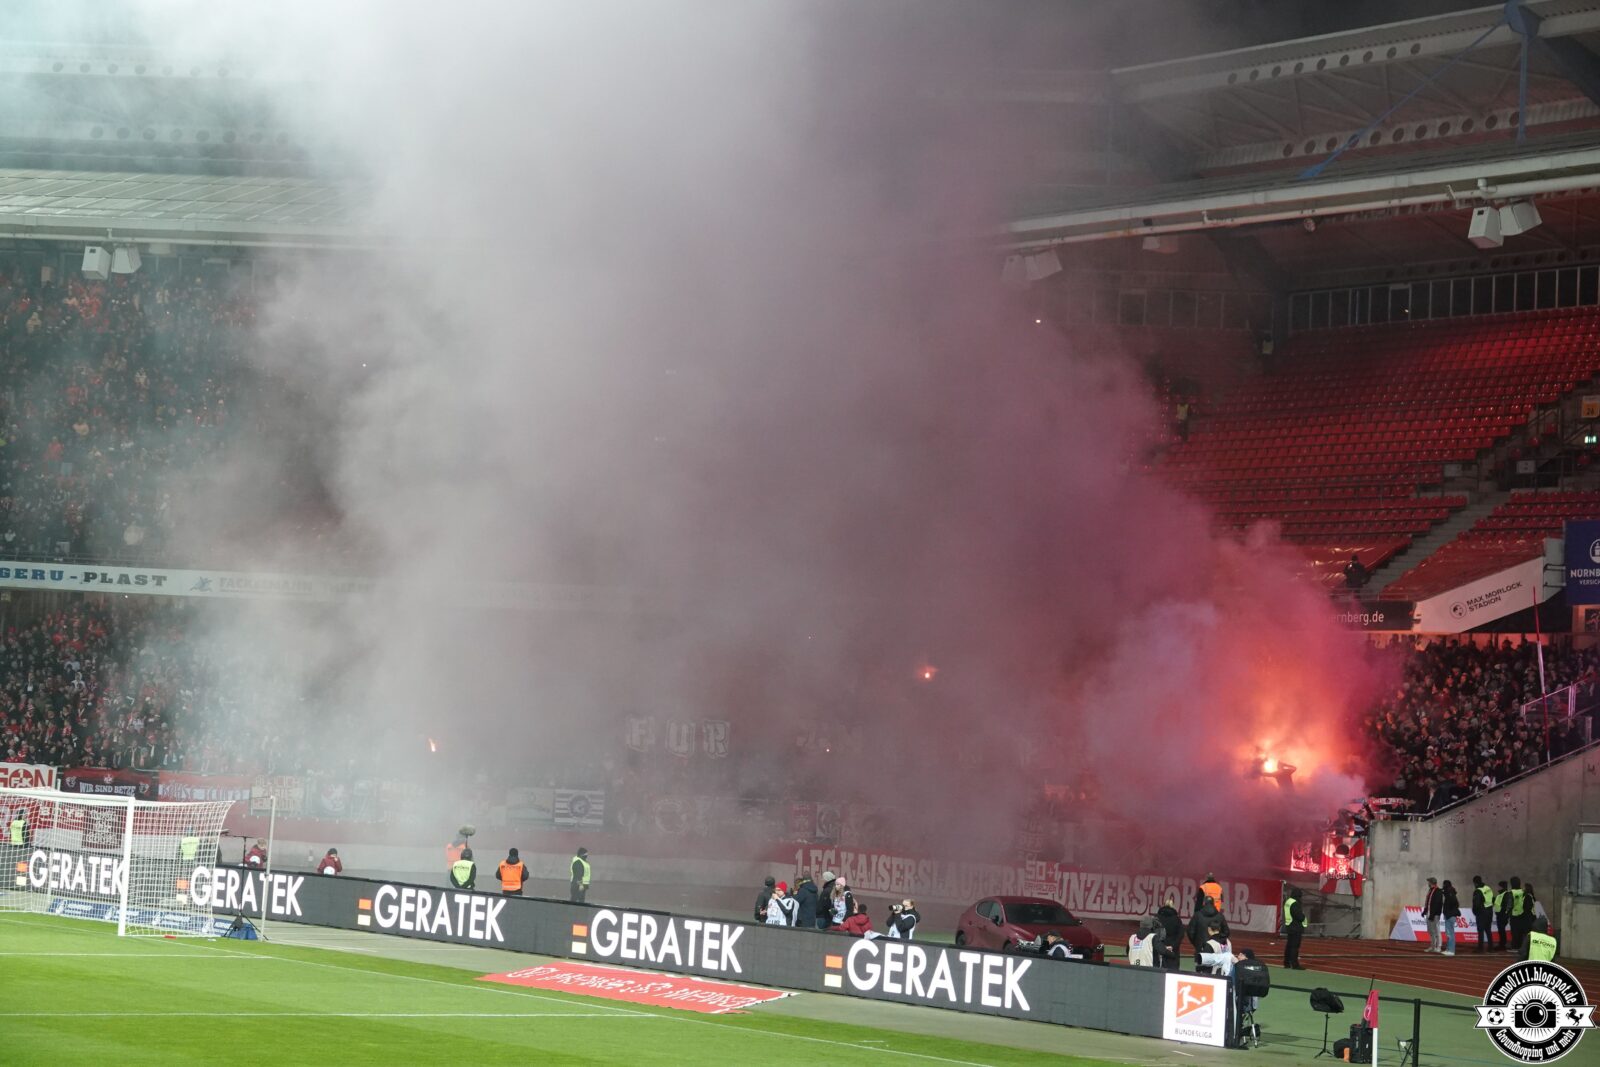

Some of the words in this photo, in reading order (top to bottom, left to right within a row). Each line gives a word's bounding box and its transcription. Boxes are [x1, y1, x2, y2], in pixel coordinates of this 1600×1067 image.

[1466, 595, 1484, 606] MAX
[1485, 581, 1523, 600] MORLOCK
[1468, 596, 1502, 612] STADION
[79, 781, 94, 793] WIR
[95, 784, 113, 793] SIND
[29, 850, 123, 896] GERATEK
[190, 866, 304, 916] GERATEK
[374, 885, 507, 942] GERATEK
[1058, 872, 1250, 923] UNZERSTÖRAR
[591, 909, 744, 973] GERATEK
[847, 940, 1032, 1011] GERATEK
[1175, 1028, 1213, 1039] BUNDESLIGA
